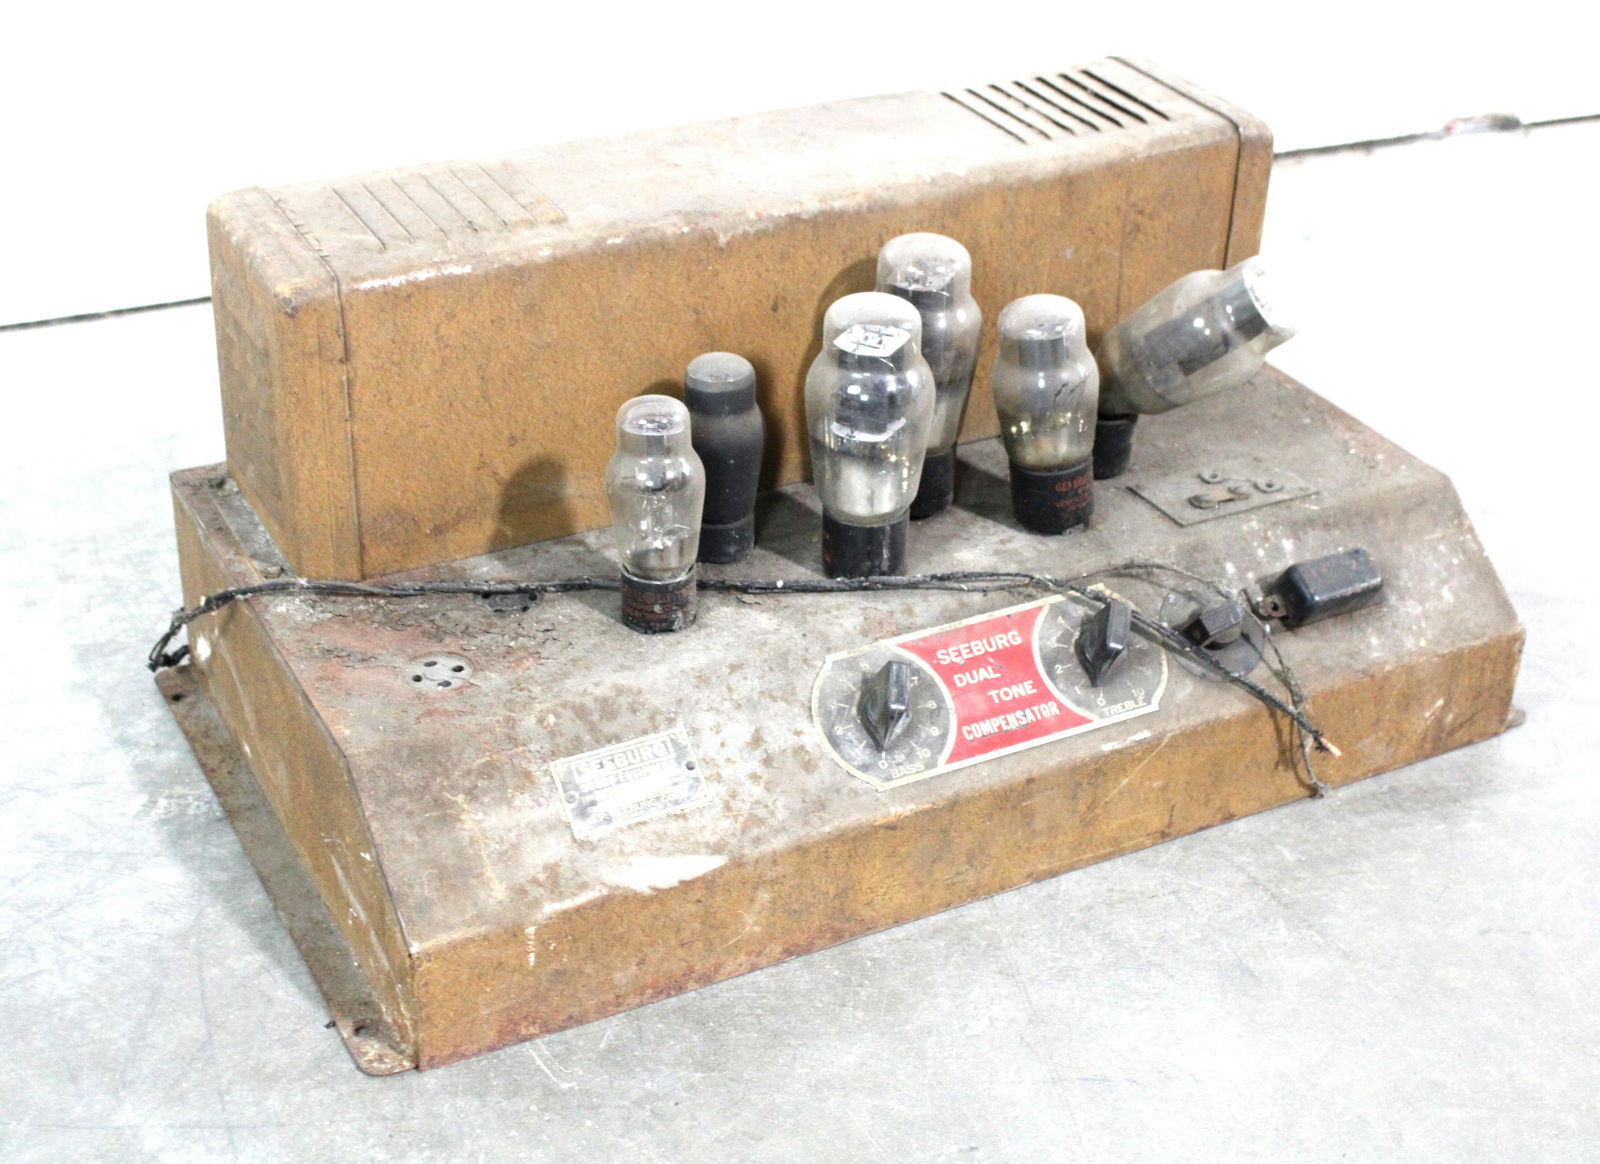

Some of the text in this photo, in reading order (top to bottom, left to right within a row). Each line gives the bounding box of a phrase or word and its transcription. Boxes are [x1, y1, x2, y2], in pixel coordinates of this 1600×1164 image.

[936, 630, 1023, 665] SEEBURG
[953, 665, 1002, 688] DUAL
[1054, 664, 1064, 674] 2
[986, 680, 1038, 704] TONE
[1100, 697, 1147, 717] TREBLE
[834, 725, 844, 736] 2
[961, 700, 1061, 741] COMPENSATOR
[890, 762, 925, 779] BASS
